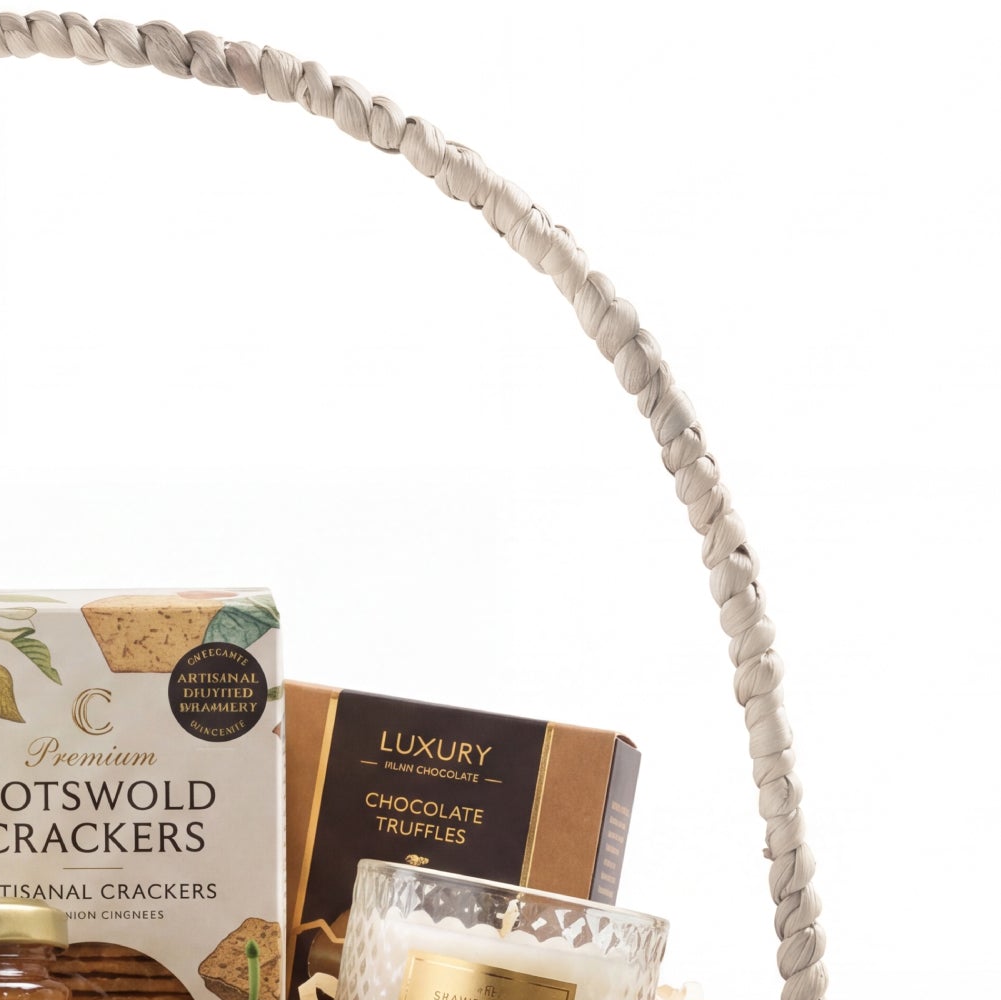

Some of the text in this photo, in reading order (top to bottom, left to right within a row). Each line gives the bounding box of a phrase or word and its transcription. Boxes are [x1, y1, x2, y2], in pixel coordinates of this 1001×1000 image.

[177, 673, 259, 684] ARTISANAL
[24, 736, 157, 768] Premium
[380, 731, 492, 766] LUXURY
[416, 765, 480, 783] CHOCOLATE
[365, 792, 485, 824] CHOCOLATE
[376, 816, 466, 845] TRUFFLES
[101, 883, 217, 900] CRACKERS
[101, 910, 164, 920] CINGNEES
